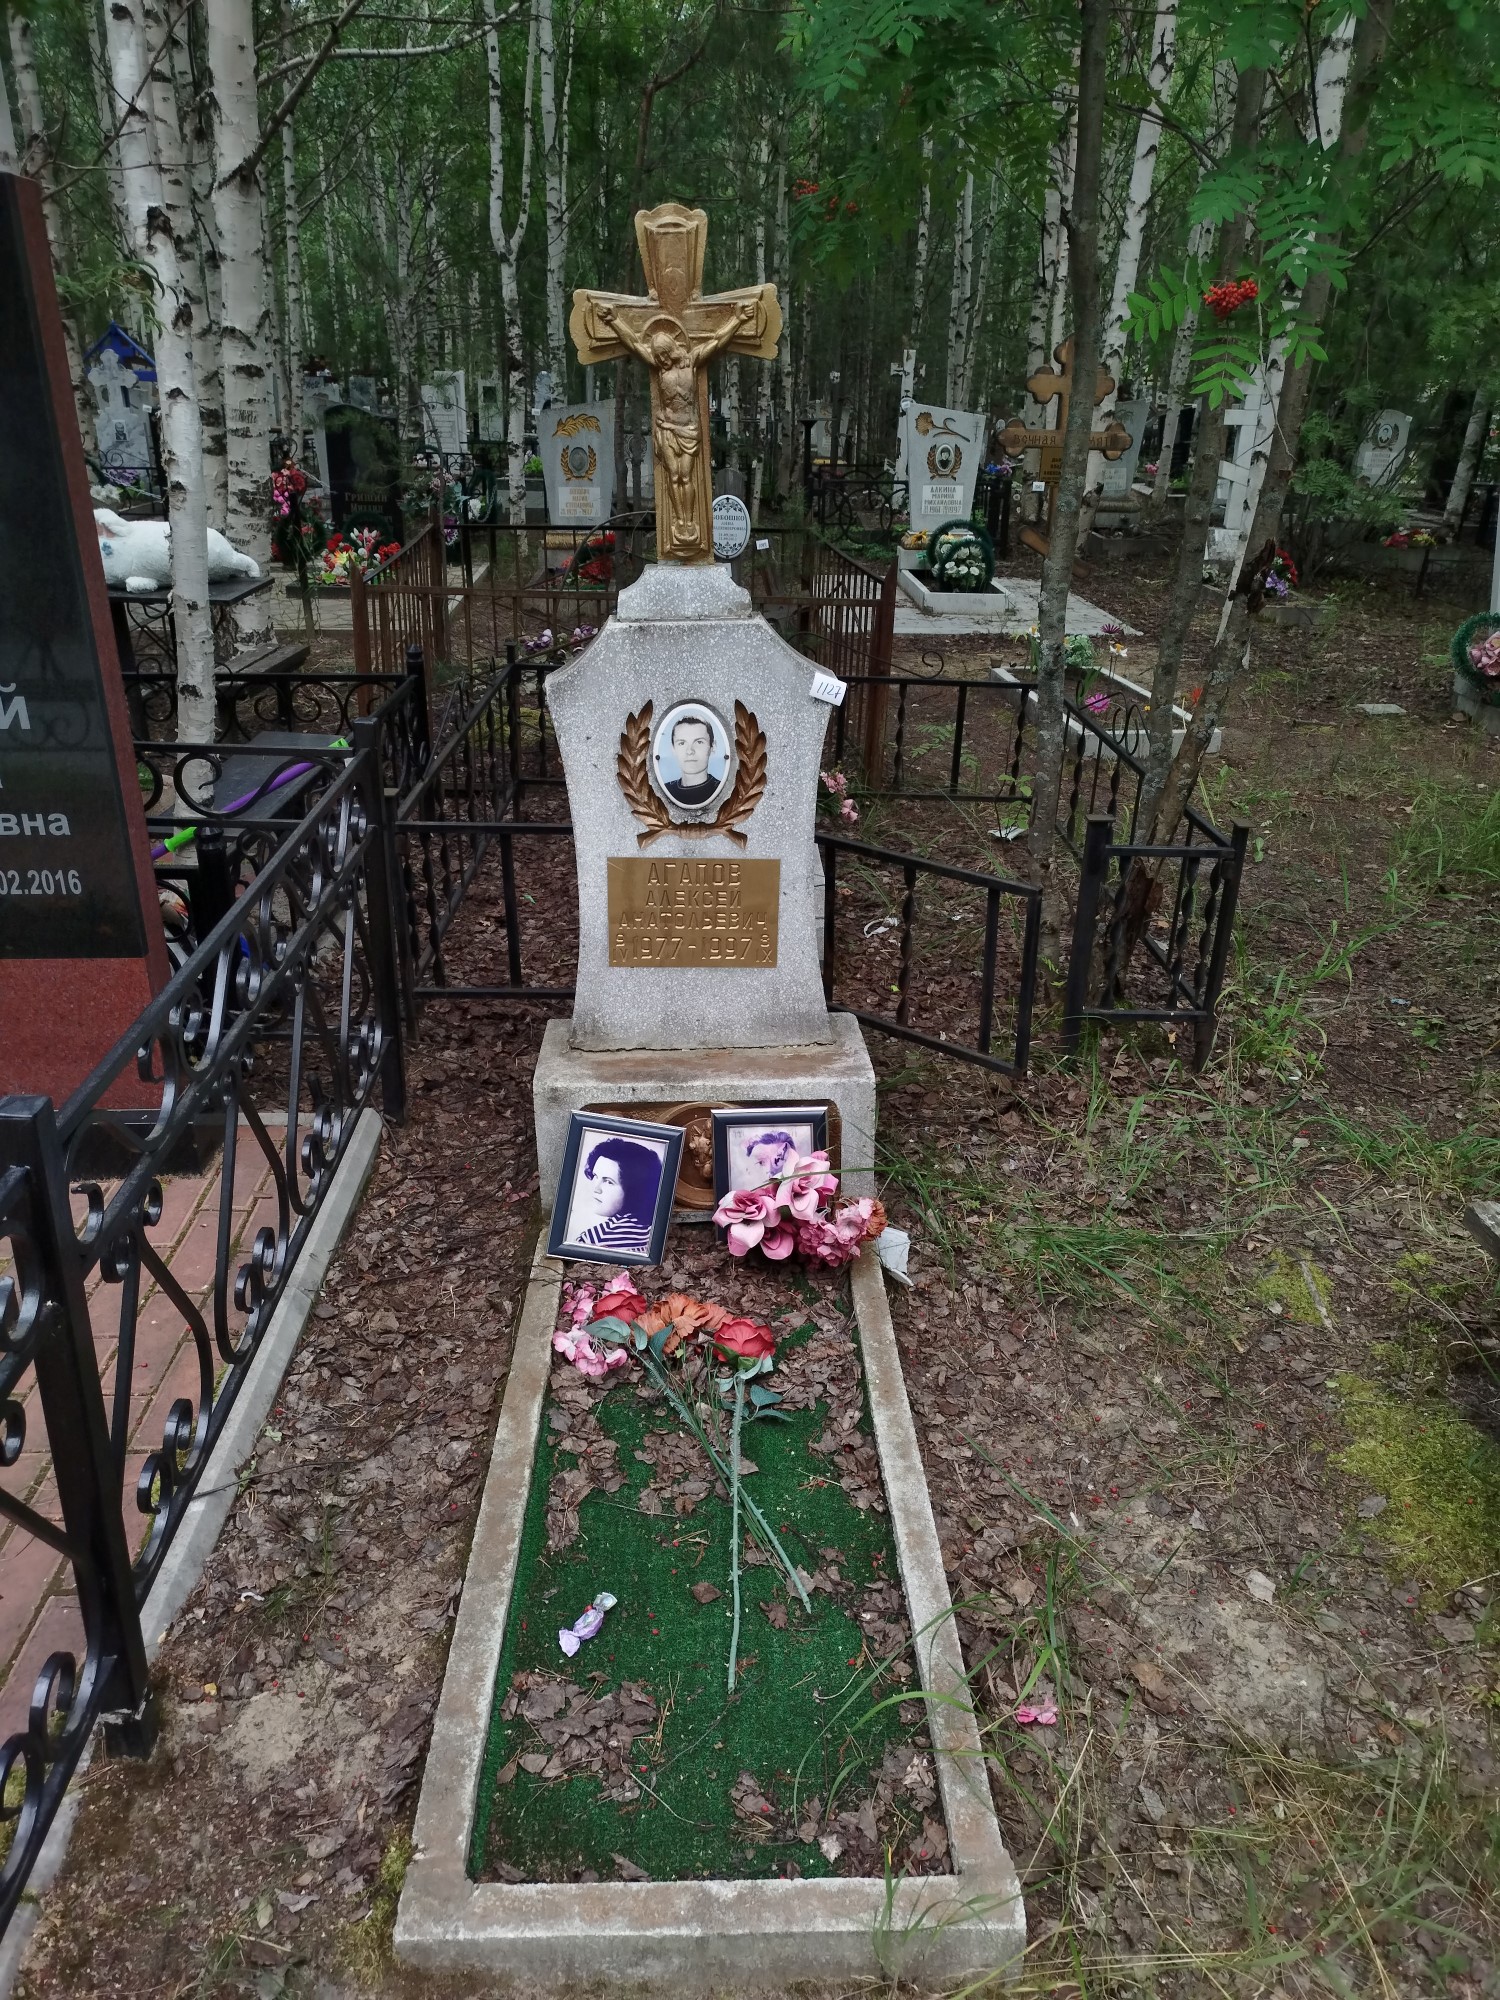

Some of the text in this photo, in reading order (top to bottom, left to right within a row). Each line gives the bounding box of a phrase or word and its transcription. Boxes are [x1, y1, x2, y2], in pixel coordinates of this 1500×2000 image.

[816, 681, 842, 699] 1127
[647, 862, 742, 887] АГАПОВ
[645, 886, 742, 909] АЛЕКСЕЙ
[618, 911, 769, 931] АНАТОЛЬЕВИЧ
